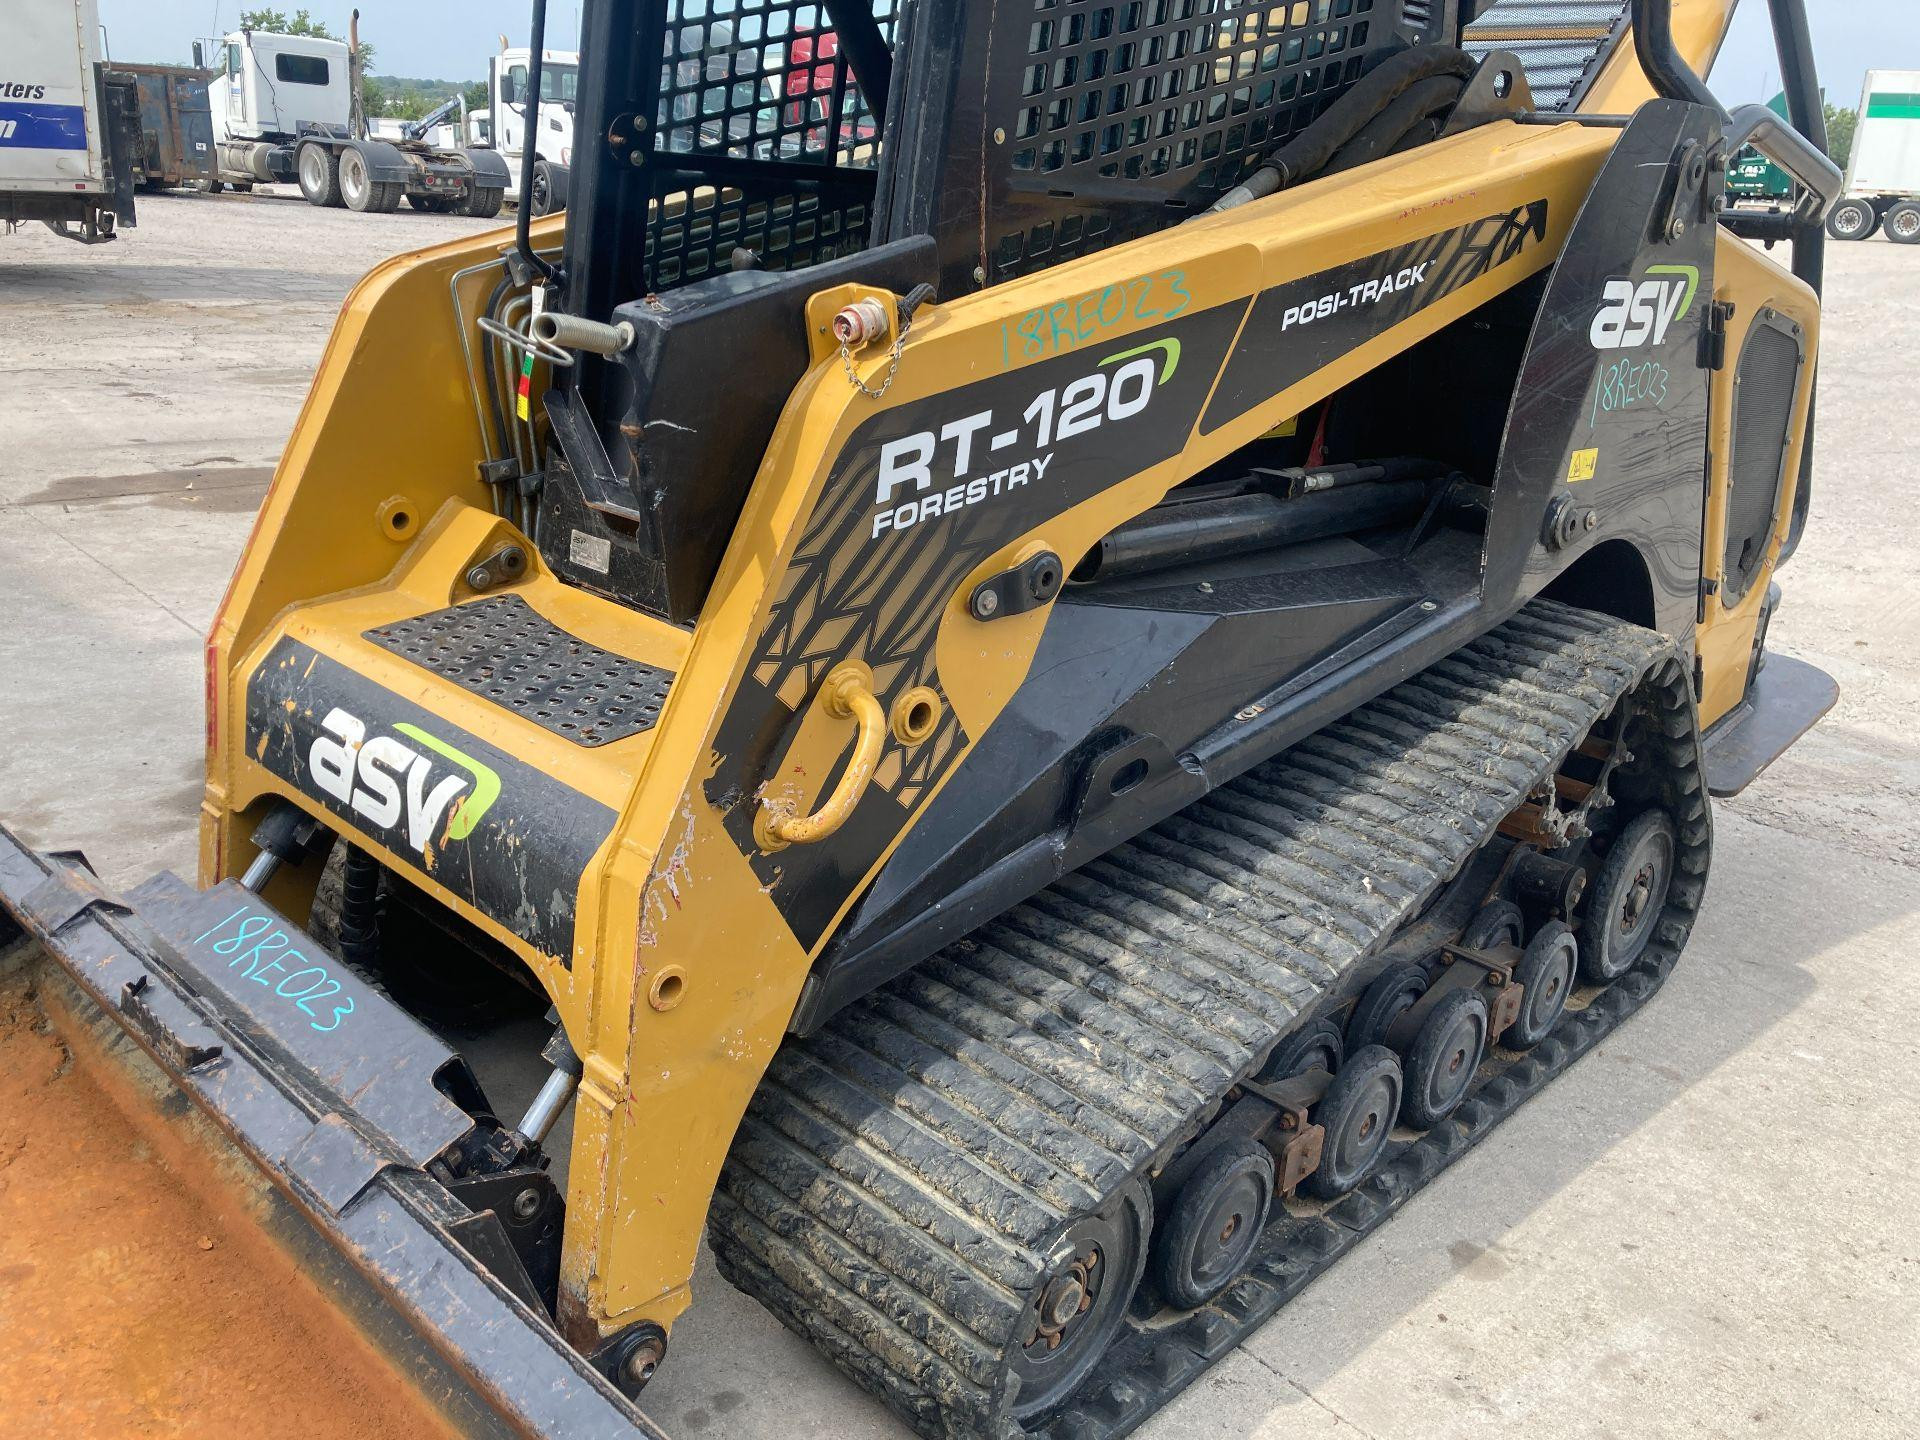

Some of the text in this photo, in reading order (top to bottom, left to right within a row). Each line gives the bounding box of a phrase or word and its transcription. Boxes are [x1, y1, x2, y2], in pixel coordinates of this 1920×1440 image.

[1001, 270, 1192, 369] 18RE023
[1280, 262, 1428, 332] POSI-TRACK
[875, 357, 1155, 505] RT-120
[1590, 357, 1670, 429] 18RE023
[871, 452, 1054, 540] FORESTRY
[193, 905, 355, 1032] 18RE023
